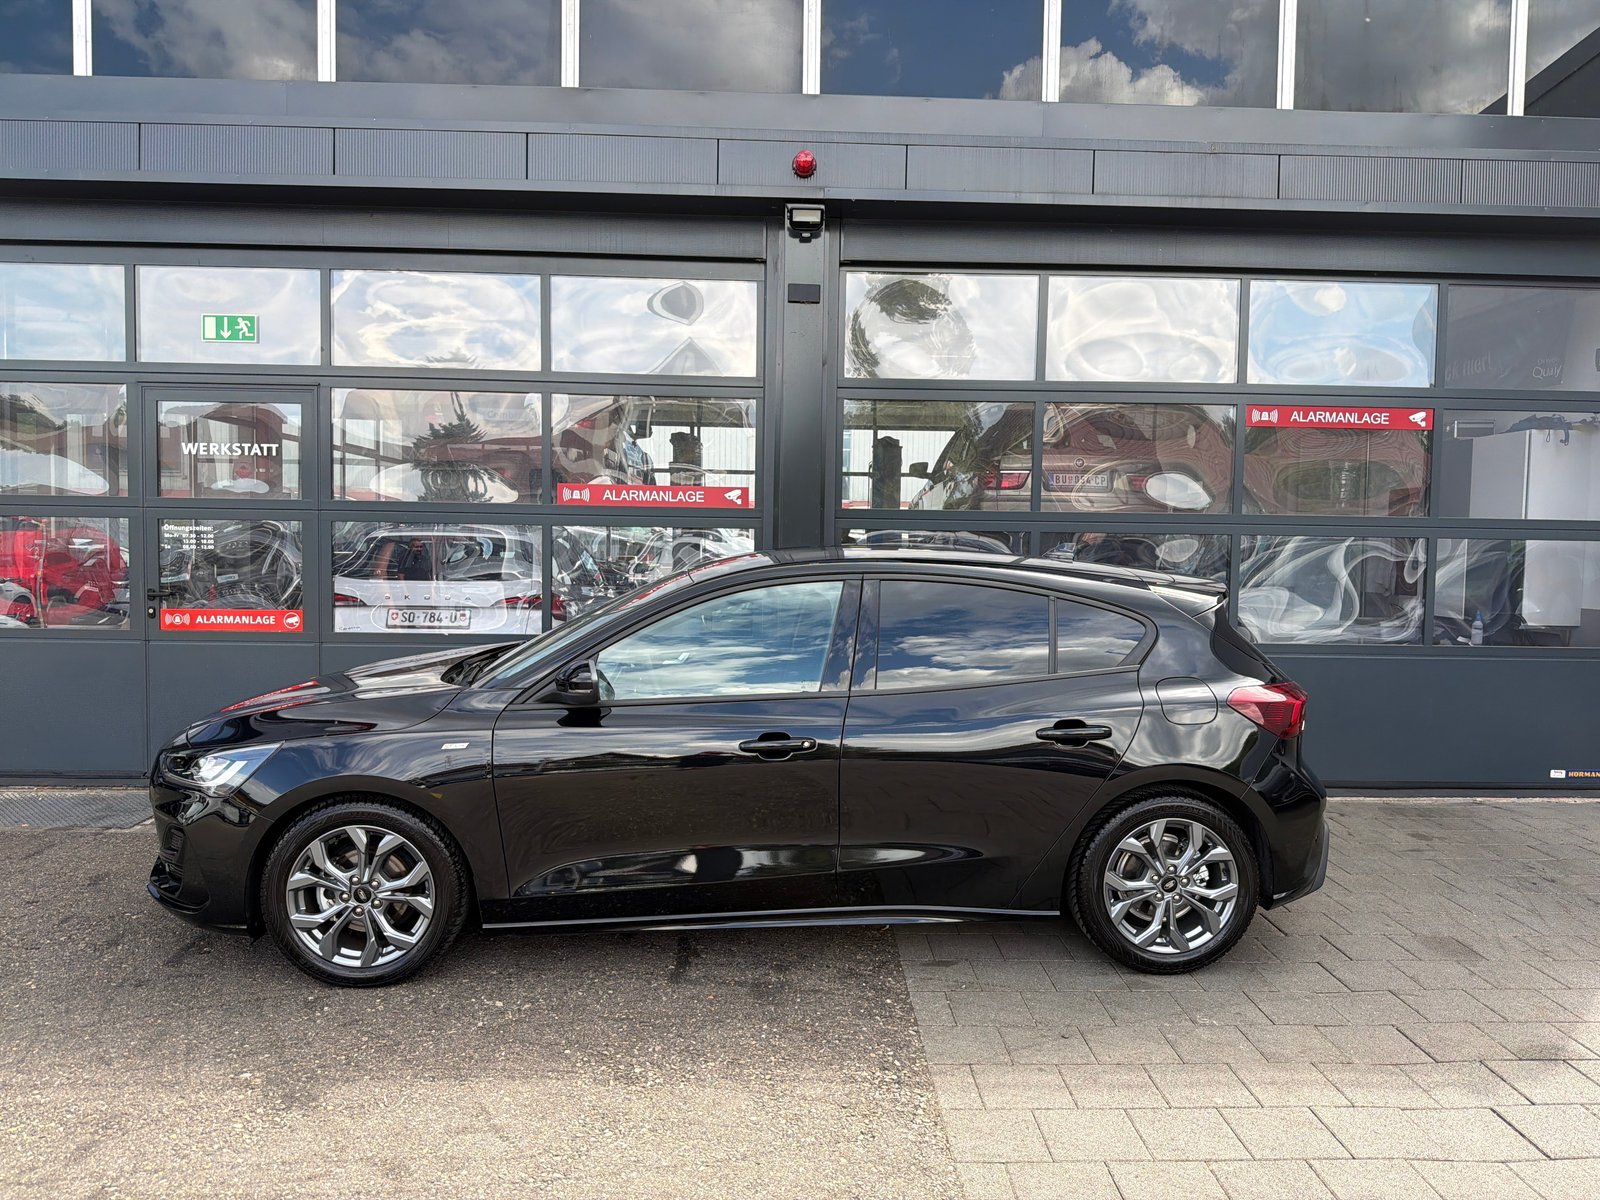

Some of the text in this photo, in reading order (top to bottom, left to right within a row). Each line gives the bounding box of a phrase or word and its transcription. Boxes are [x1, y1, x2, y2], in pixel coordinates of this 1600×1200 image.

[1290, 411, 1390, 424] ALARMANLAGE
[181, 442, 279, 456] WERKSTATT
[602, 489, 705, 503] ALARMANLAGE
[195, 615, 276, 625] ALARMANLAGE
